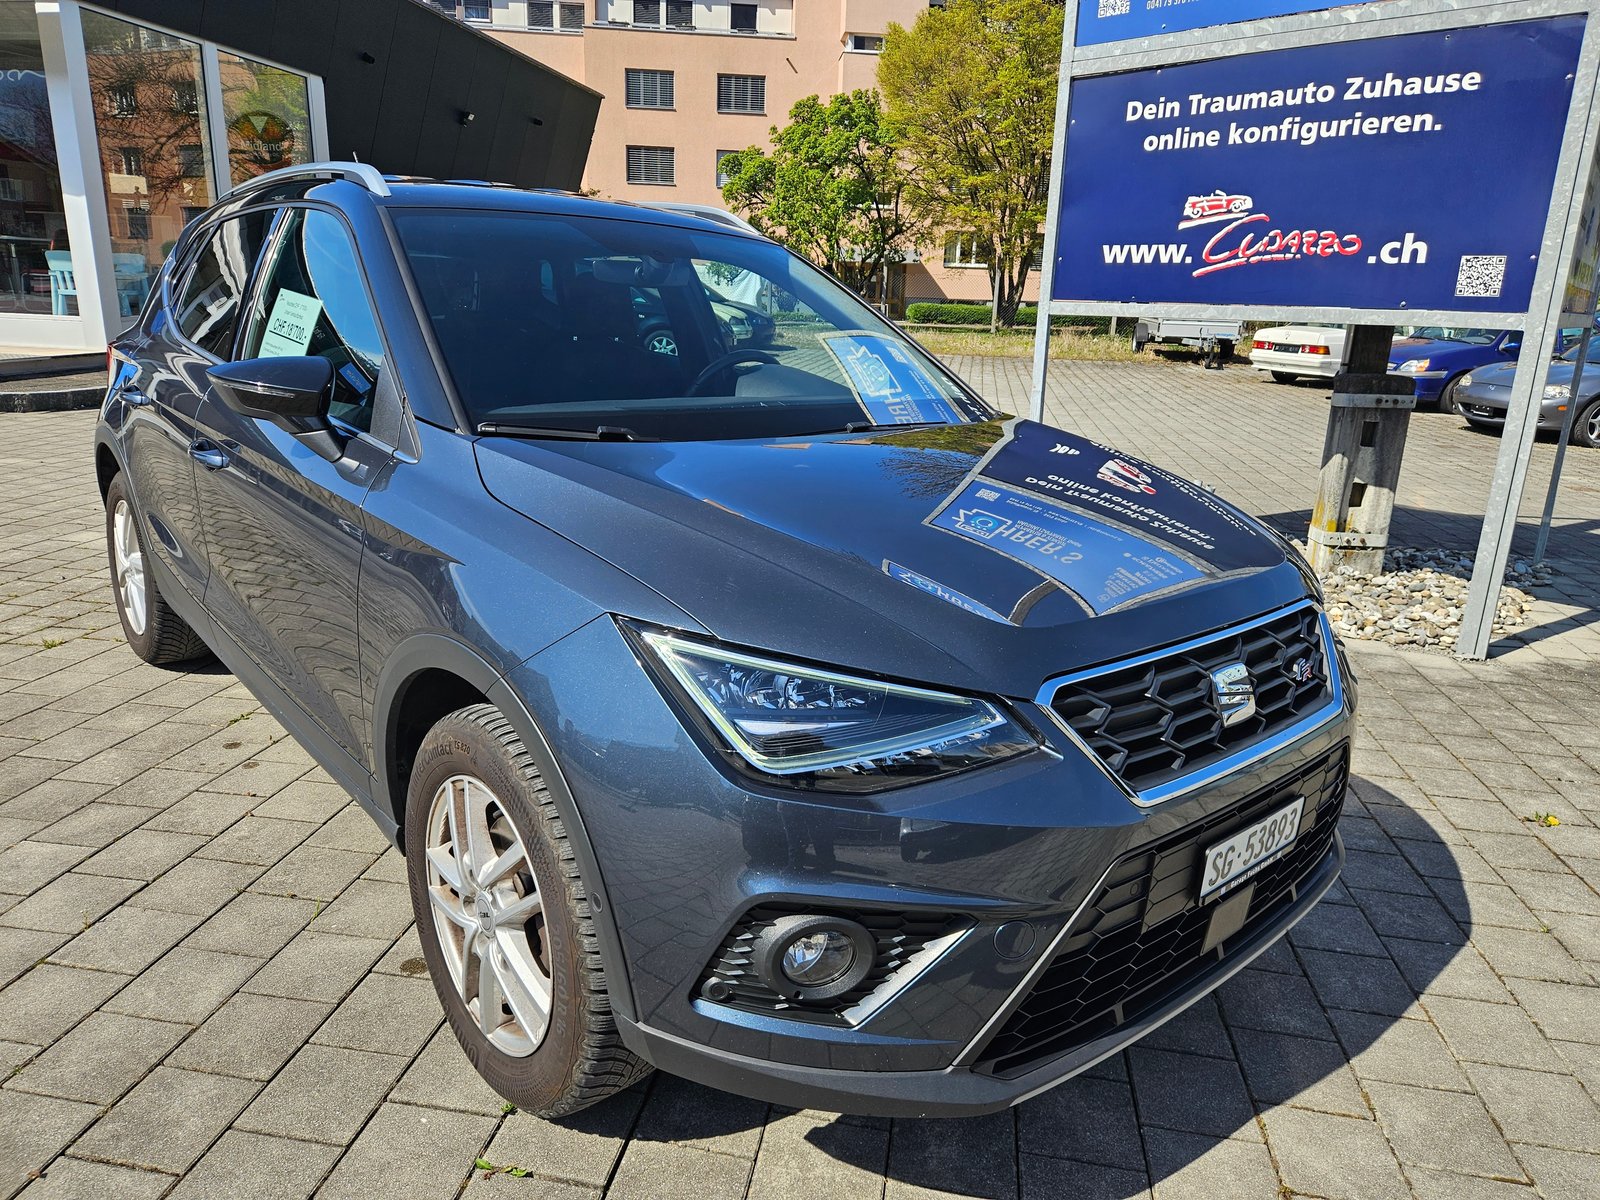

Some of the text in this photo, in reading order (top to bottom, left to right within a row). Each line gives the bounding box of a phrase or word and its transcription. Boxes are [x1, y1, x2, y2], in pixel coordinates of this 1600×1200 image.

[1126, 70, 1482, 122] Dein Traumauto Zuhause
[1142, 110, 1442, 152] online konfigurieren.
